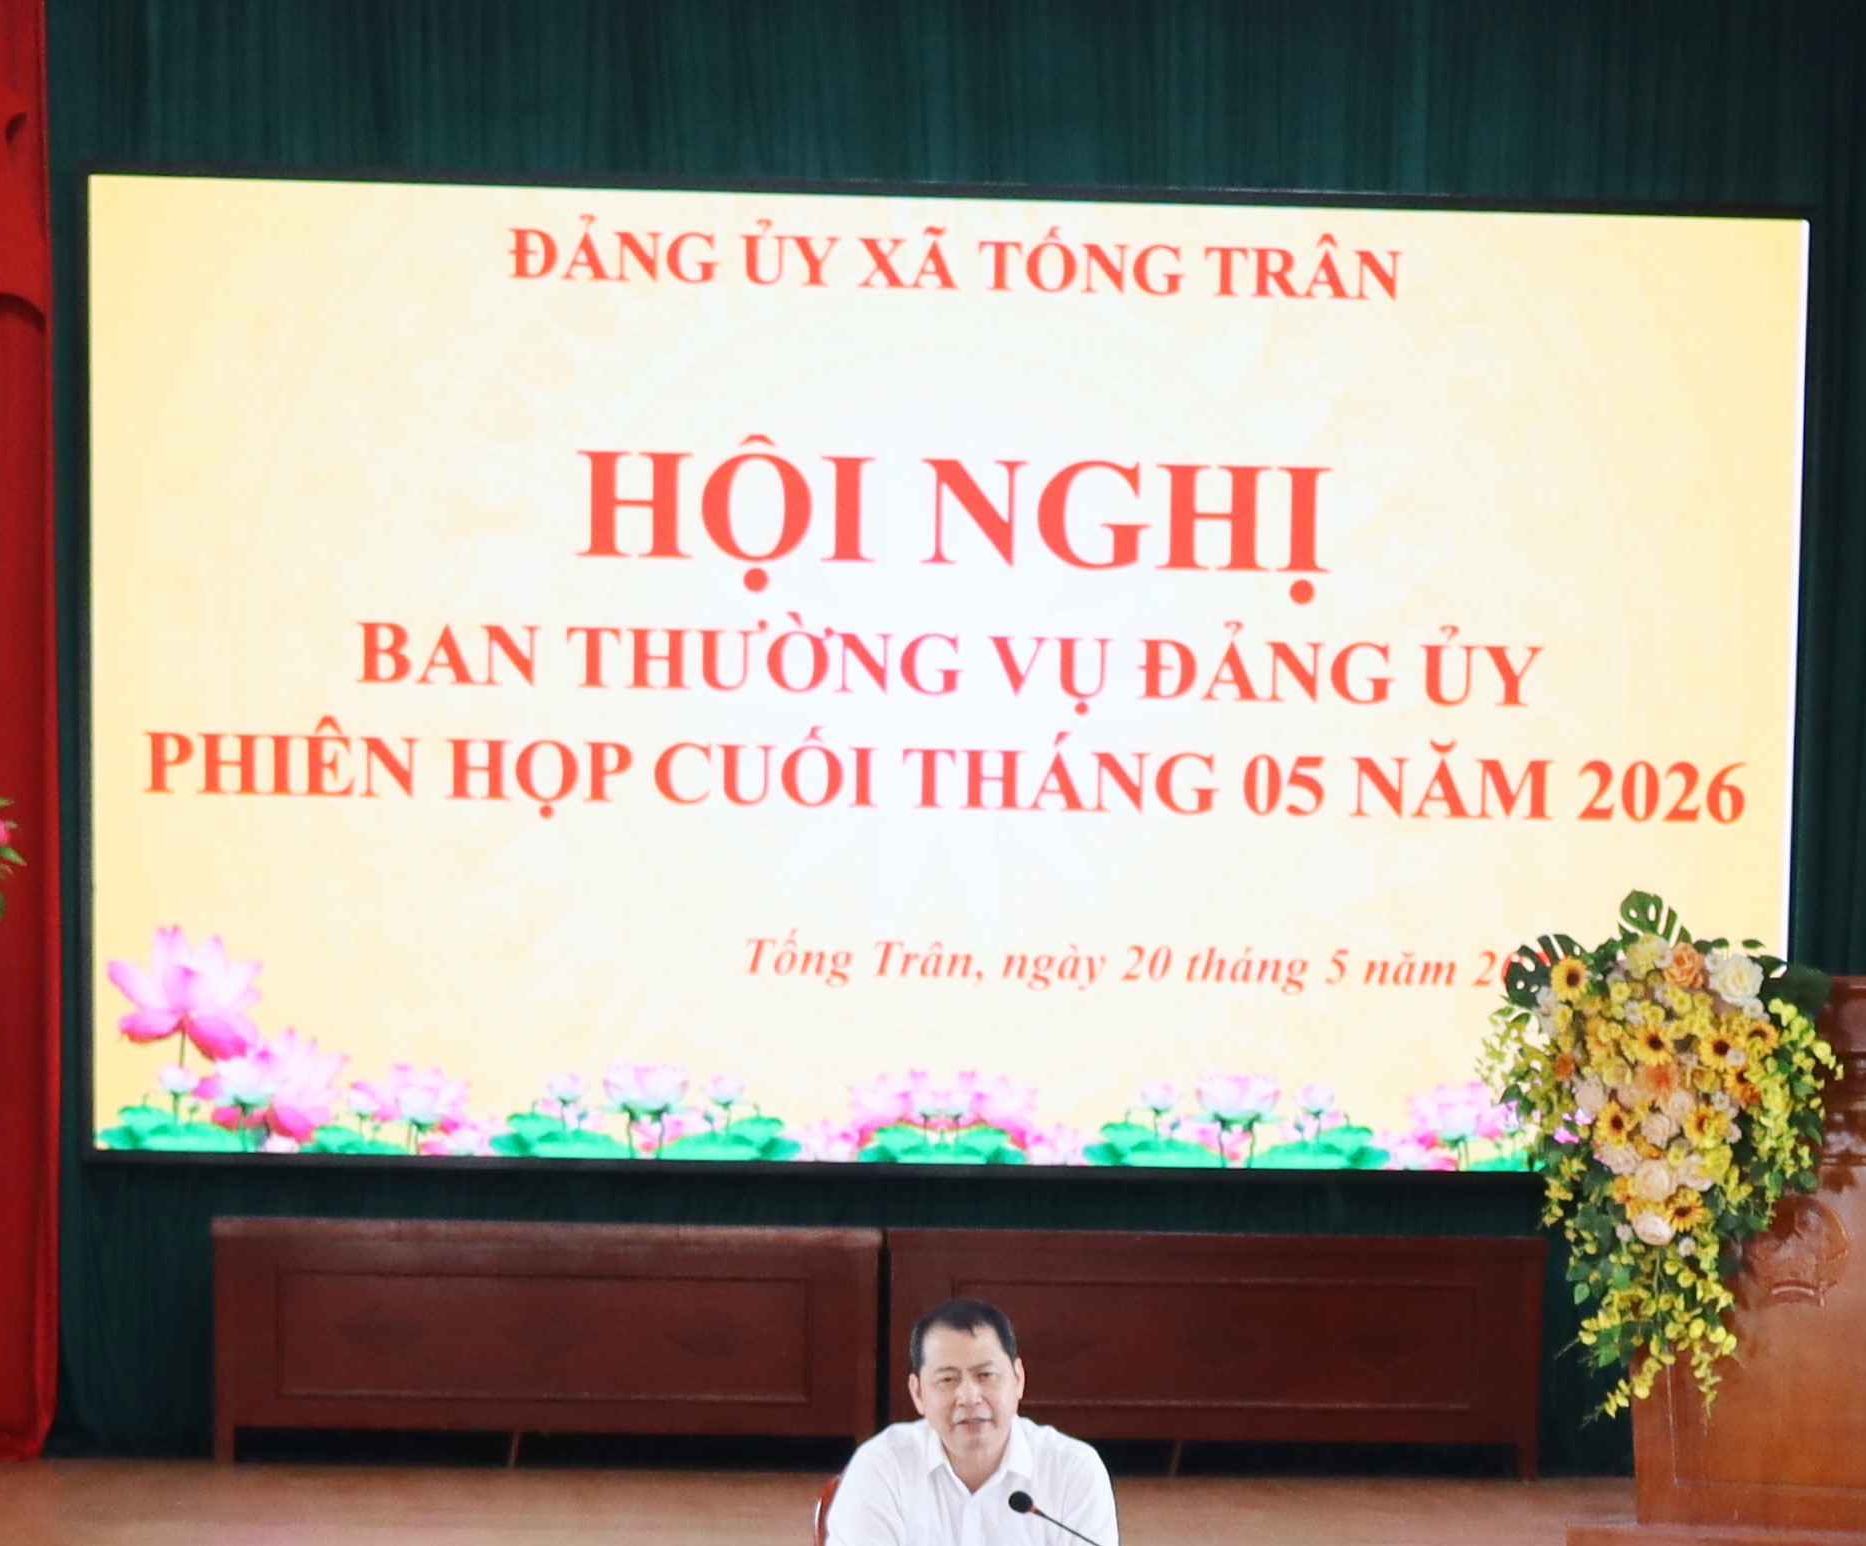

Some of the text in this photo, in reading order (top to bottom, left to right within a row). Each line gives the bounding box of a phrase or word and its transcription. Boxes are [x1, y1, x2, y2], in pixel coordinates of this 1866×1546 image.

[509, 214, 1400, 300] ĐẢNG ỦY XÃ TỐNG TRÂN
[577, 434, 1331, 605] HỘI NGHỊ
[359, 611, 1543, 715] BAN THƯỜNG VỤ ĐẢNG ỦY
[145, 715, 1745, 824] PHIÊN HỌP CUỐI THÁNG 05 NĂM 2026
[743, 929, 854, 989] Tống
[873, 940, 984, 987] Trân,
[1001, 945, 1106, 991] ngày
[1121, 945, 1172, 983] 20
[1186, 945, 1309, 996] tháng
[1325, 947, 1350, 985] 5
[1364, 950, 1456, 987] năm
